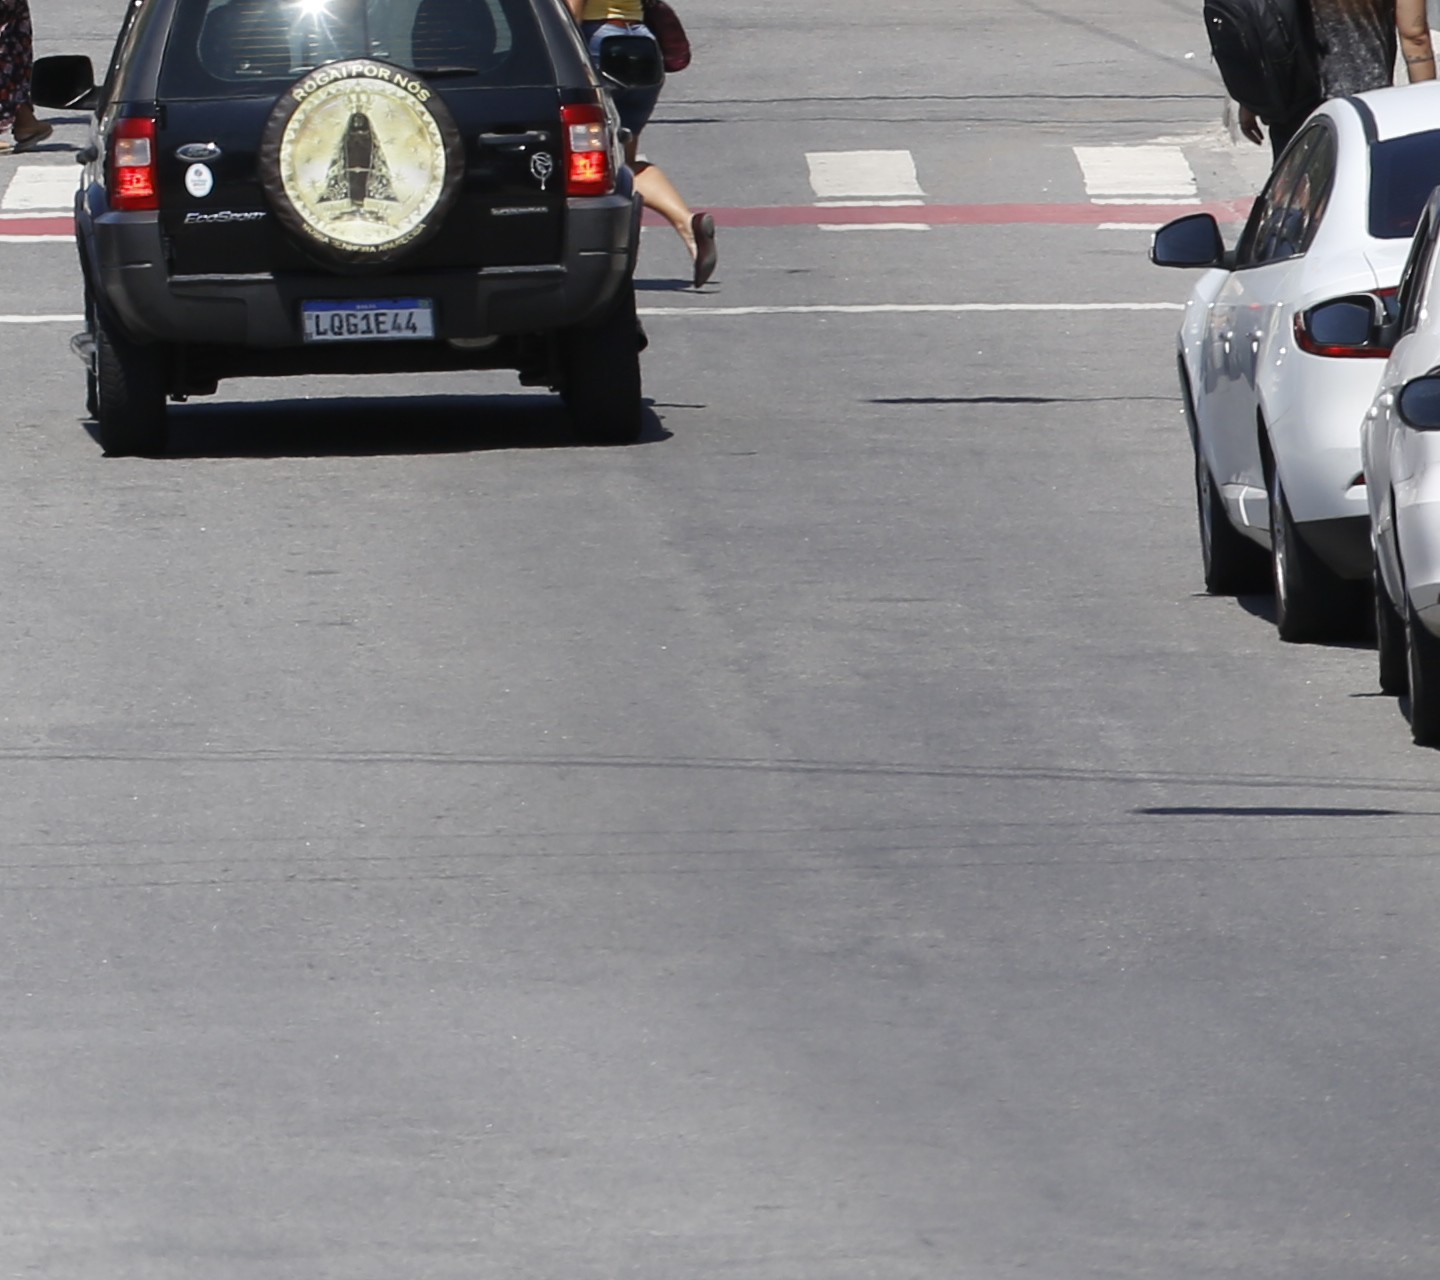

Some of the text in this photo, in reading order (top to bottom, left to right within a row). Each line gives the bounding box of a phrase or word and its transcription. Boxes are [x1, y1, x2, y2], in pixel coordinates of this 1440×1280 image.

[291, 64, 431, 102] ROGAI POR NÓS
